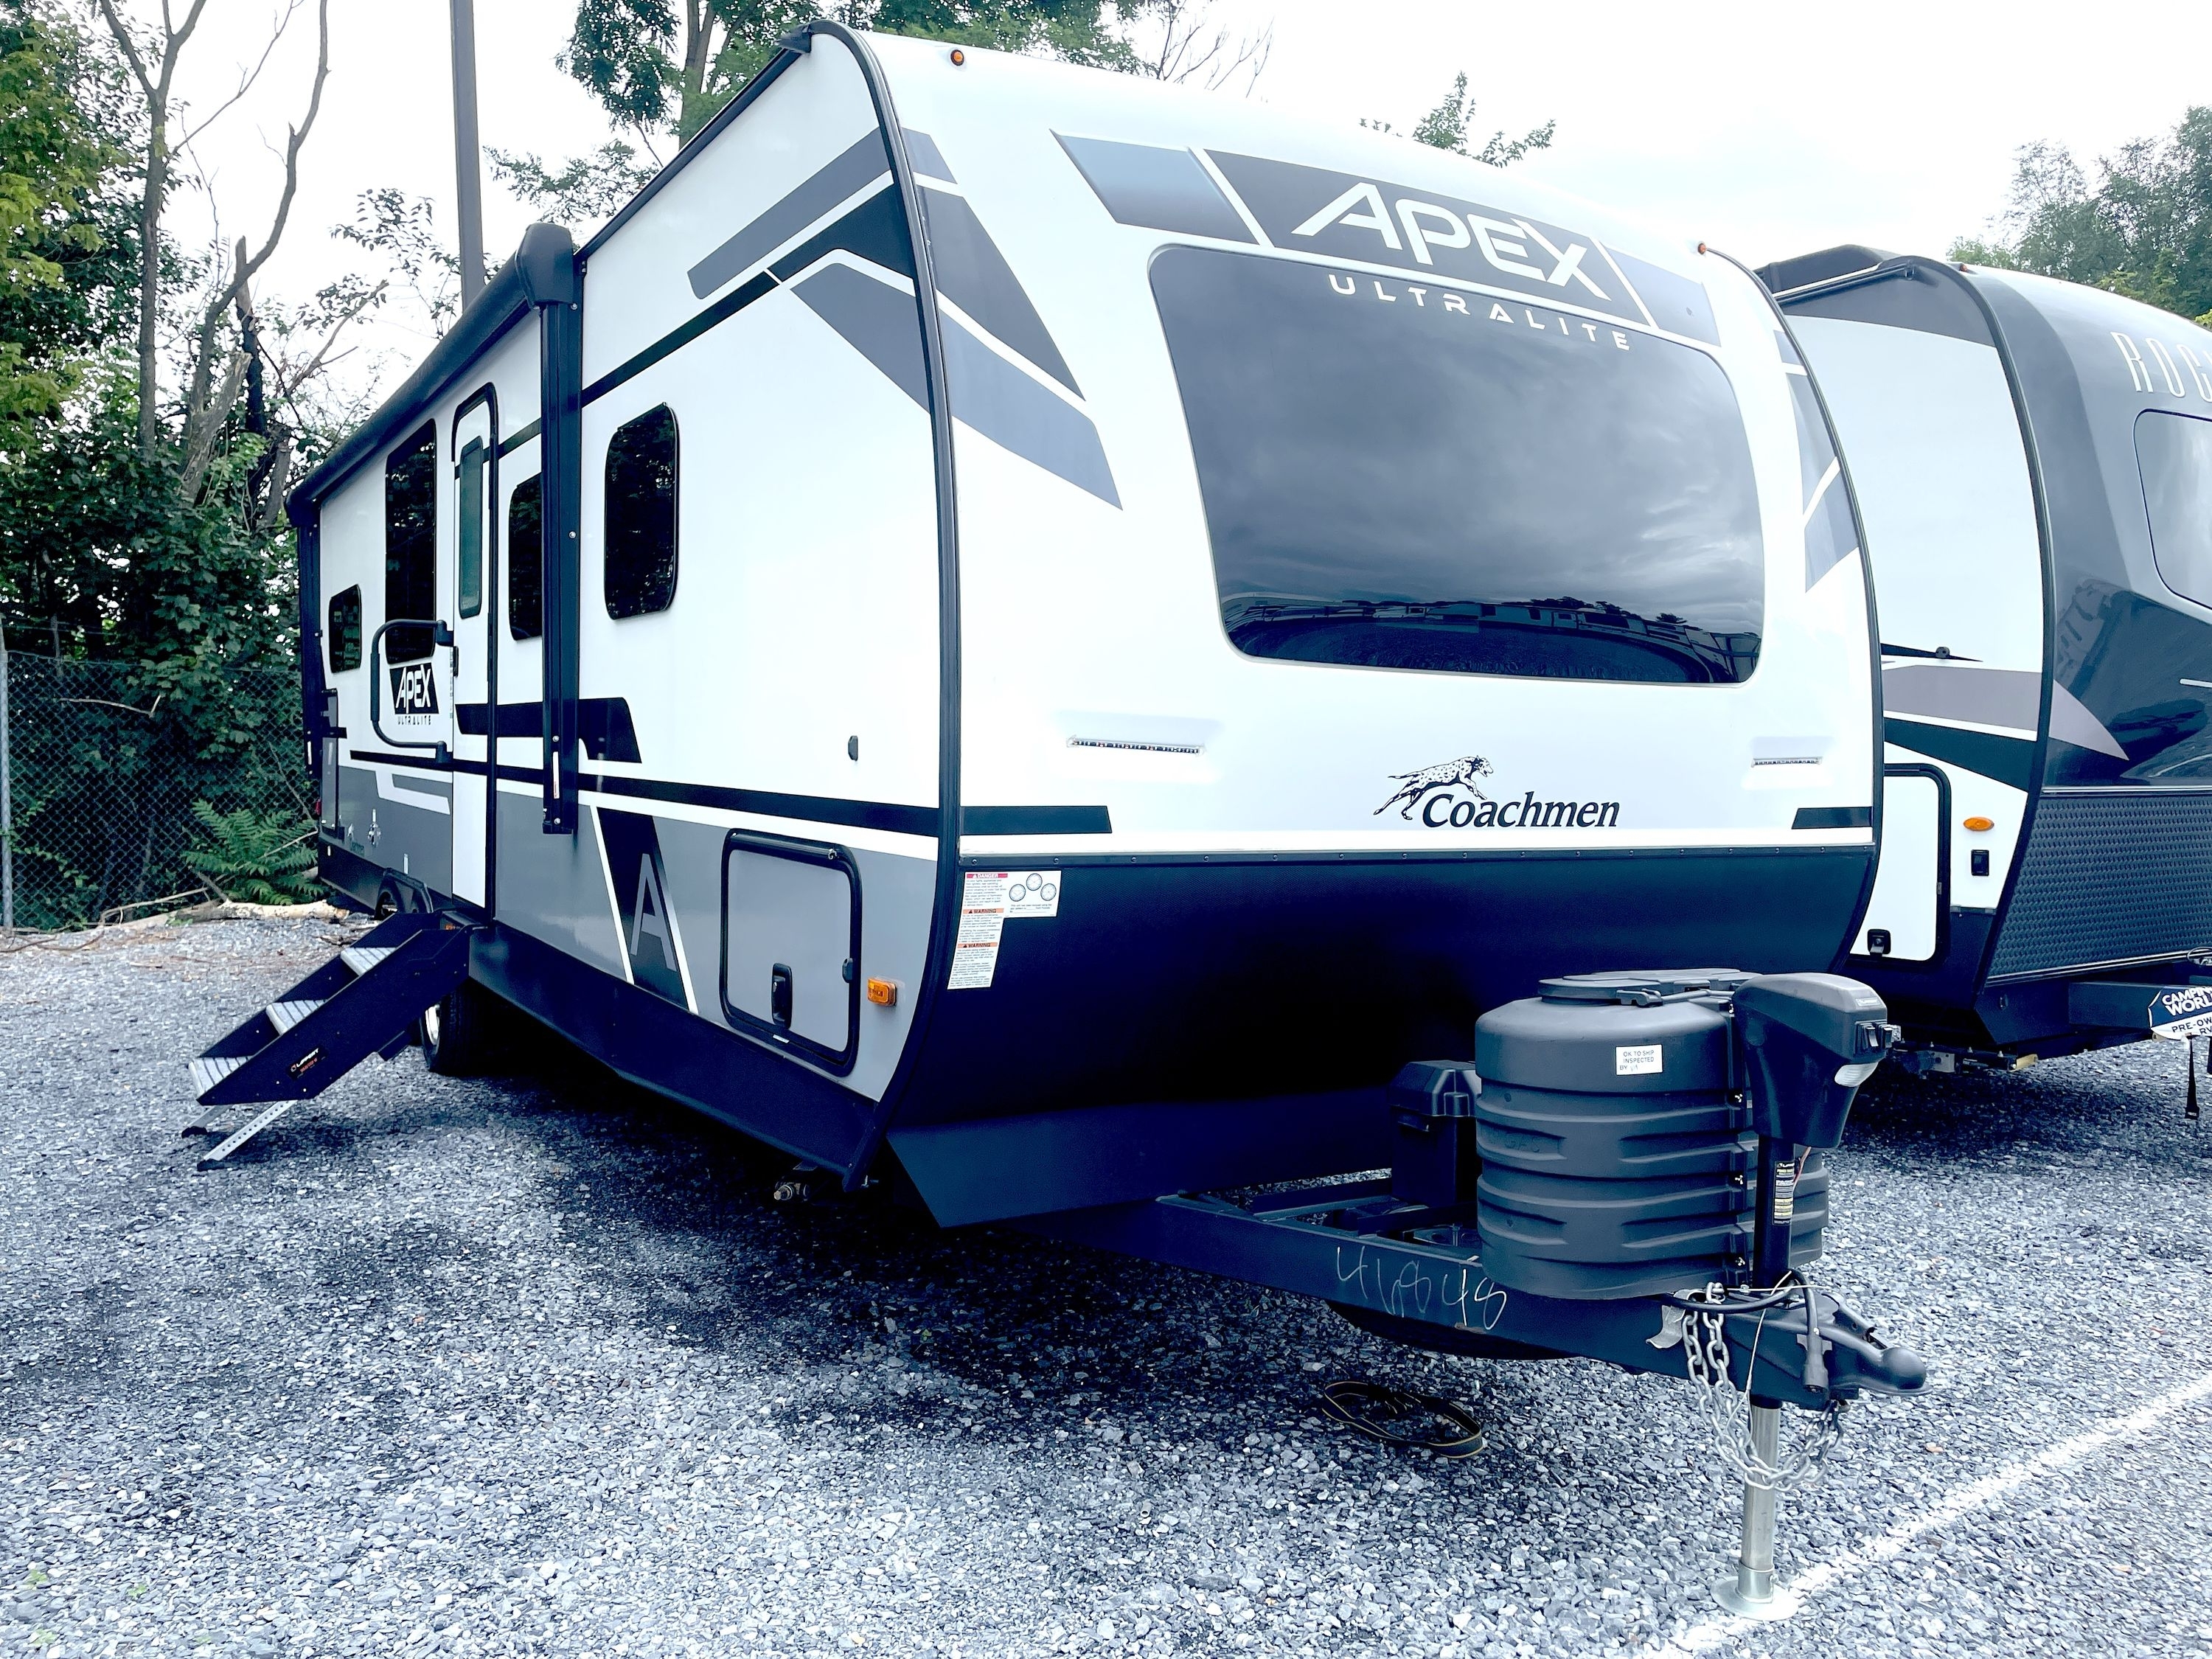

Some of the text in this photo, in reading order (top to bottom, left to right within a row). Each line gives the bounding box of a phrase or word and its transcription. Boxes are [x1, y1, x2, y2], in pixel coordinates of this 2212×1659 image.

[1291, 181, 1612, 302] APEX
[1328, 274, 1631, 350] ULTRALITE
[2110, 331, 2212, 403] ROC
[395, 664, 431, 714] APEX
[397, 715, 431, 726] ULTRALITE
[1422, 791, 1621, 828] Coachmen
[630, 853, 678, 972] A
[2165, 994, 2212, 1016] WORL
